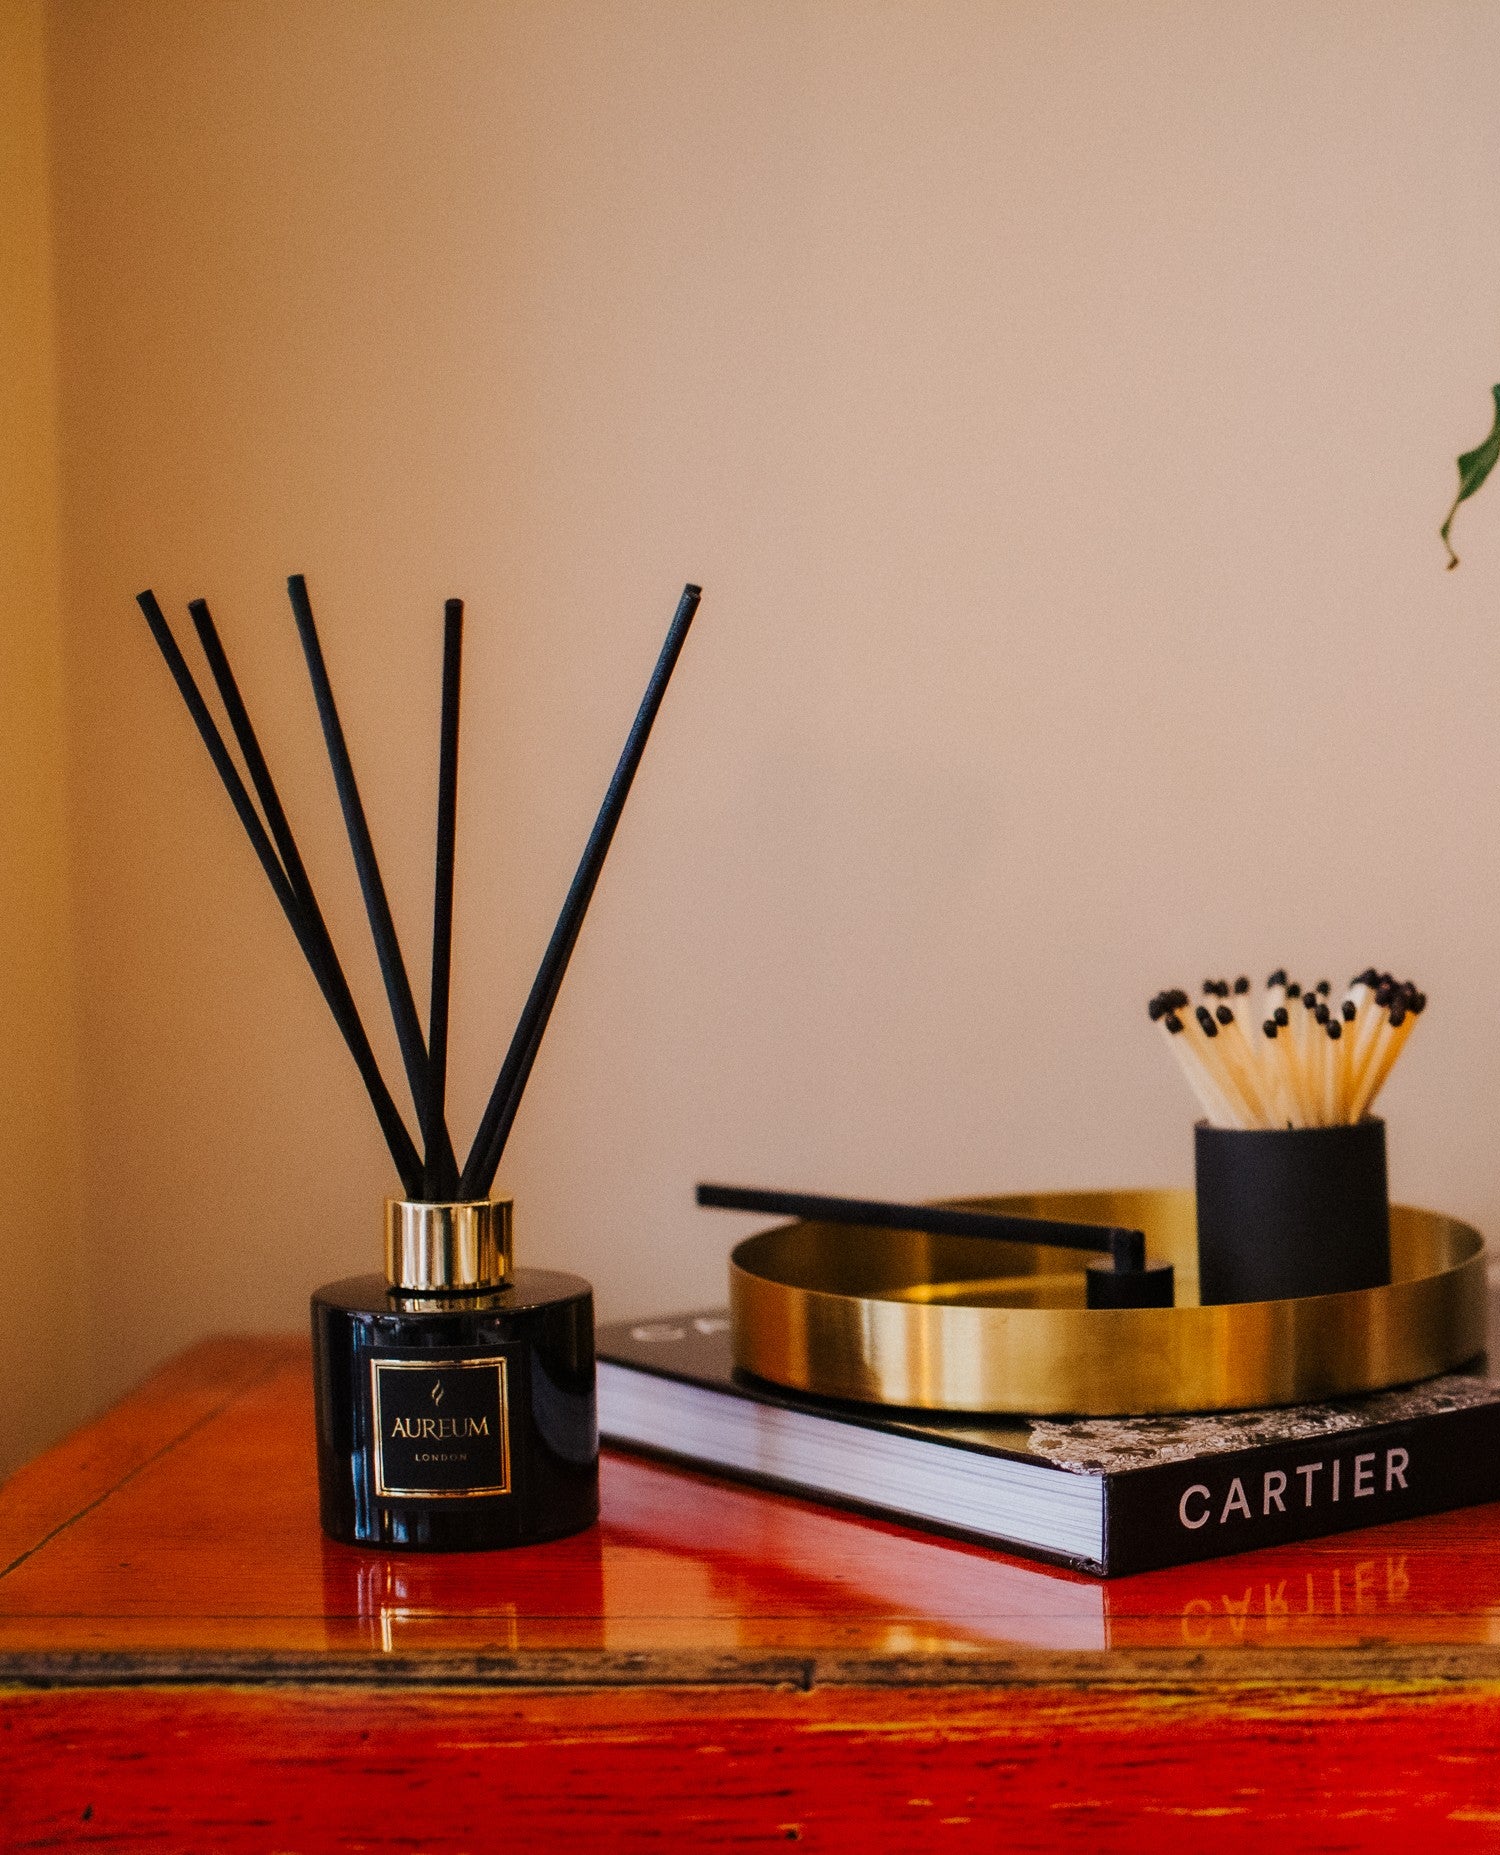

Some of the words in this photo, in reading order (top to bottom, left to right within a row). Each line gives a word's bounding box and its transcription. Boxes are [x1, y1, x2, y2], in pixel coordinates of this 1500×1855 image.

[391, 1416, 490, 1440] AUREUM
[414, 1453, 468, 1462] LONDON
[1179, 1447, 1410, 1530] CARTIER
